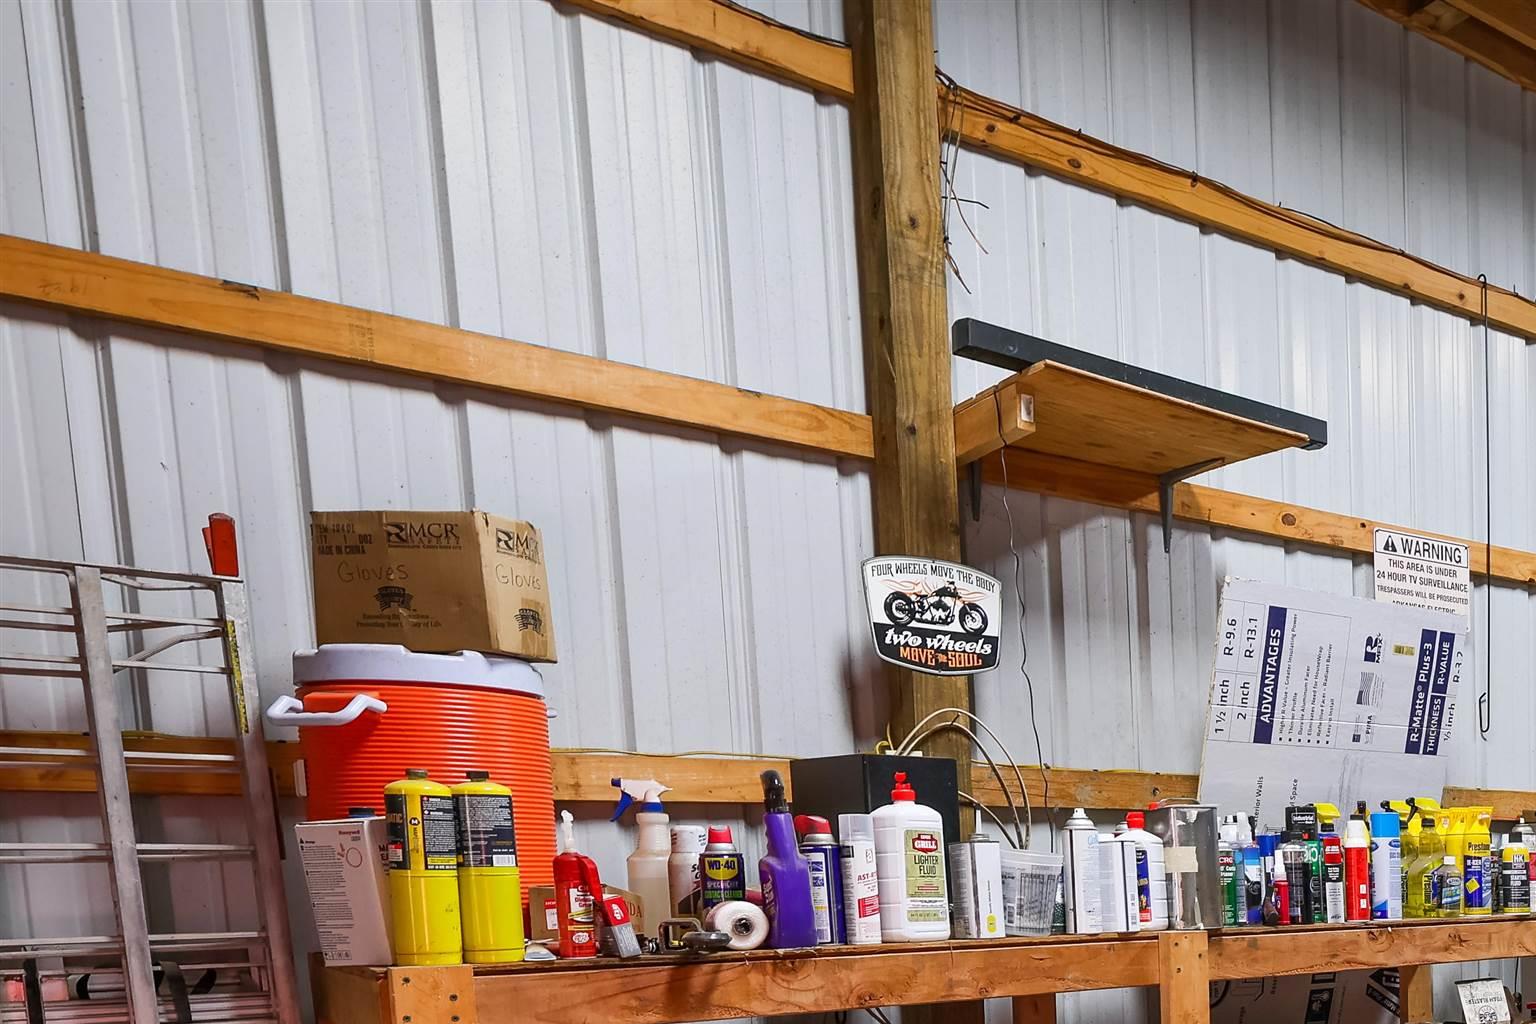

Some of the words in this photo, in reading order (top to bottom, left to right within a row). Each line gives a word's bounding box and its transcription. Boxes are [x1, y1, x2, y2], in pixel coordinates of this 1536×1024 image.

[409, 523, 457, 538] MCR
[1401, 537, 1461, 564] WARNING
[337, 560, 409, 583] Gloves
[496, 563, 541, 590] Gloves
[871, 563, 894, 577] FOUR
[895, 563, 928, 576] WHEELS
[930, 565, 954, 580] MOVE
[957, 570, 974, 584] THE
[976, 576, 996, 593] BODY
[1377, 570, 1386, 579] 24
[1388, 572, 1407, 582] HOUR
[1409, 575, 1417, 584] TV
[1420, 577, 1468, 592] SURVEILLANCE
[1388, 559, 1404, 569] THIS
[1406, 562, 1424, 573] AREA
[1427, 565, 1433, 574] IS
[1435, 567, 1457, 578] UNDER
[1377, 585, 1414, 596] TRESPASSERS
[1437, 594, 1468, 605] PROSECUTED
[884, 627, 922, 647] two
[926, 634, 993, 655] wheels
[1224, 618, 1237, 656] R-9.6
[1244, 618, 1258, 658] R-13.1
[900, 646, 935, 666] MOVE
[947, 651, 982, 668] SOUL
[1419, 643, 1433, 682] Plus-3
[1437, 641, 1450, 684] R-VALUE
[1260, 628, 1281, 723] ADVANTAGES
[1219, 679, 1230, 707] inch
[1240, 681, 1251, 708] inch
[1237, 712, 1247, 720] 2
[1427, 698, 1441, 752] THICKNESS
[1445, 703, 1456, 731] inch
[1256, 776, 1264, 797] Walls
[1290, 779, 1298, 801] Space
[915, 841, 936, 849] GRILL
[707, 860, 736, 870] WD-40
[914, 855, 938, 865] LIGHTER
[919, 866, 936, 875] FLUID
